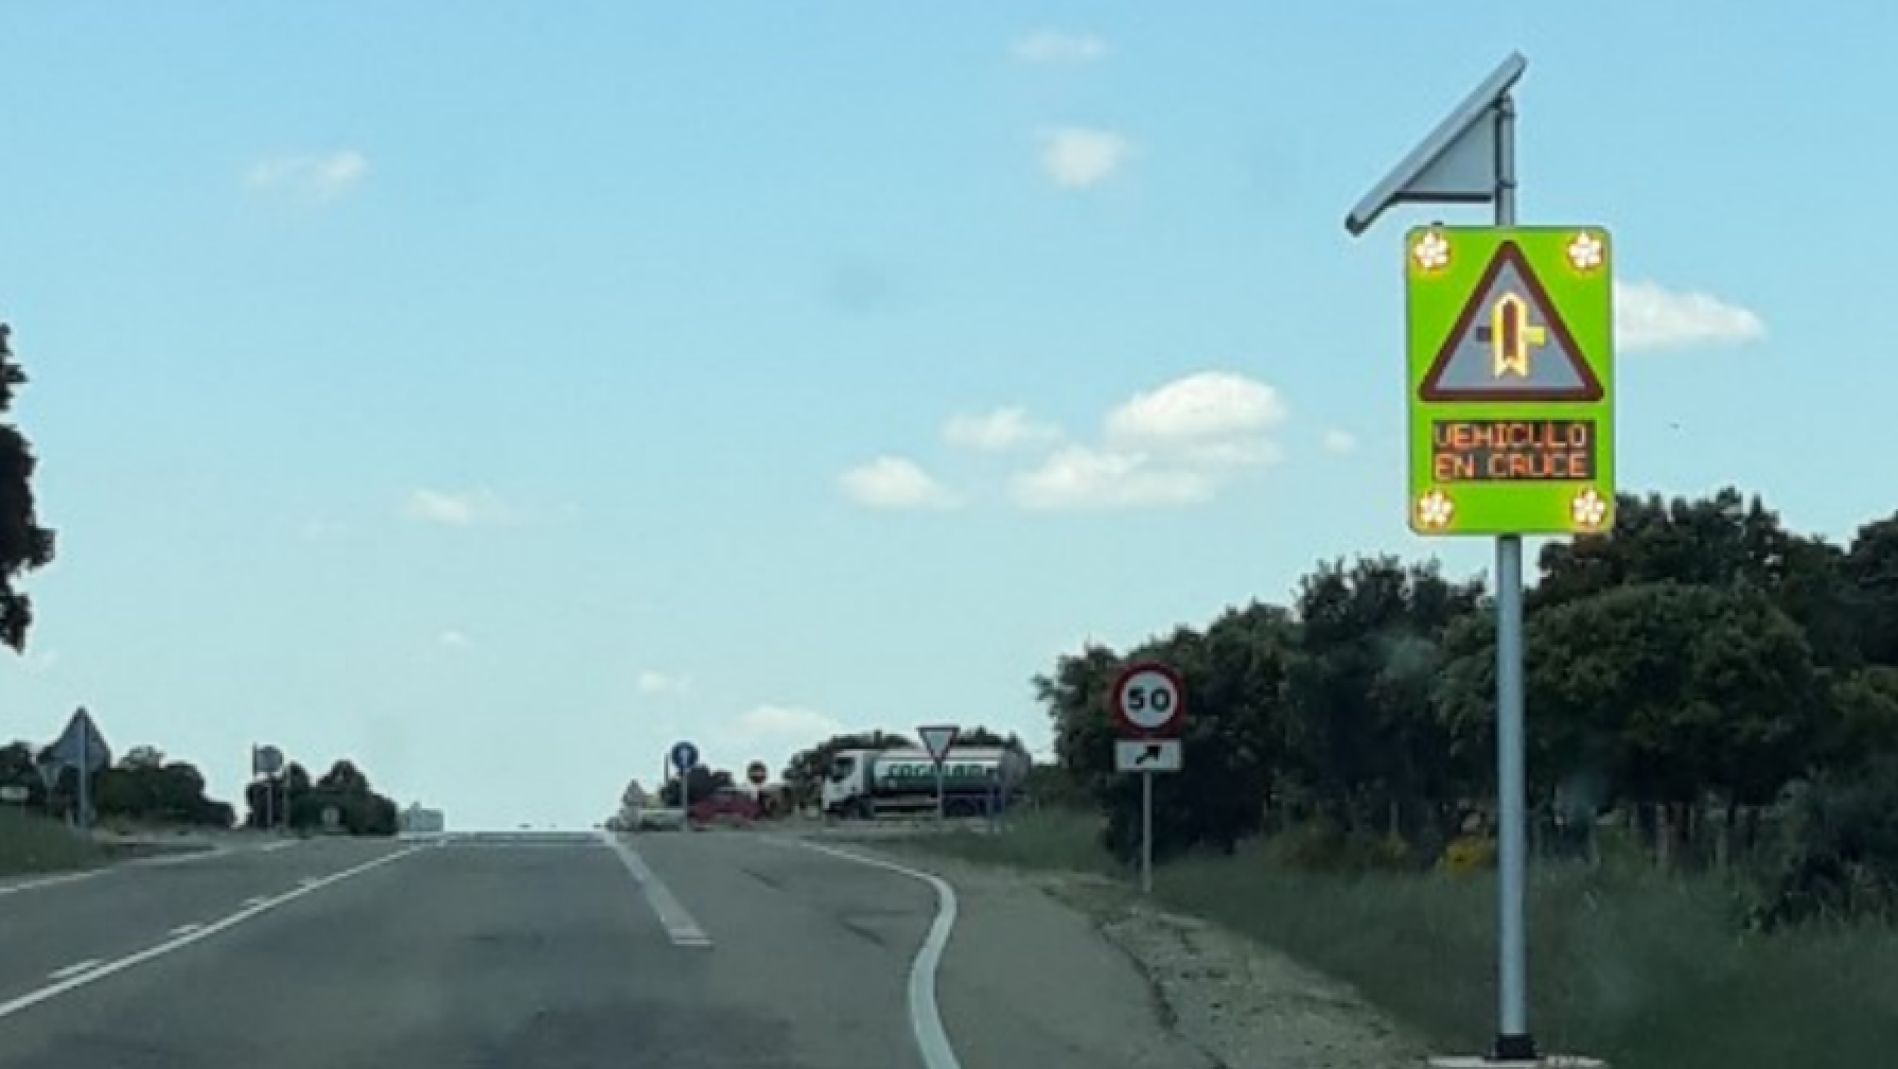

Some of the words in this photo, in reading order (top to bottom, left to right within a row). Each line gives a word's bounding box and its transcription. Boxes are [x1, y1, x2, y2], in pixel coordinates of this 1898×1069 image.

[1434, 422, 1586, 448] VEHICULO
[1435, 453, 1474, 479] EN
[1488, 453, 1587, 478] CRUCE
[1128, 687, 1171, 711] 50
